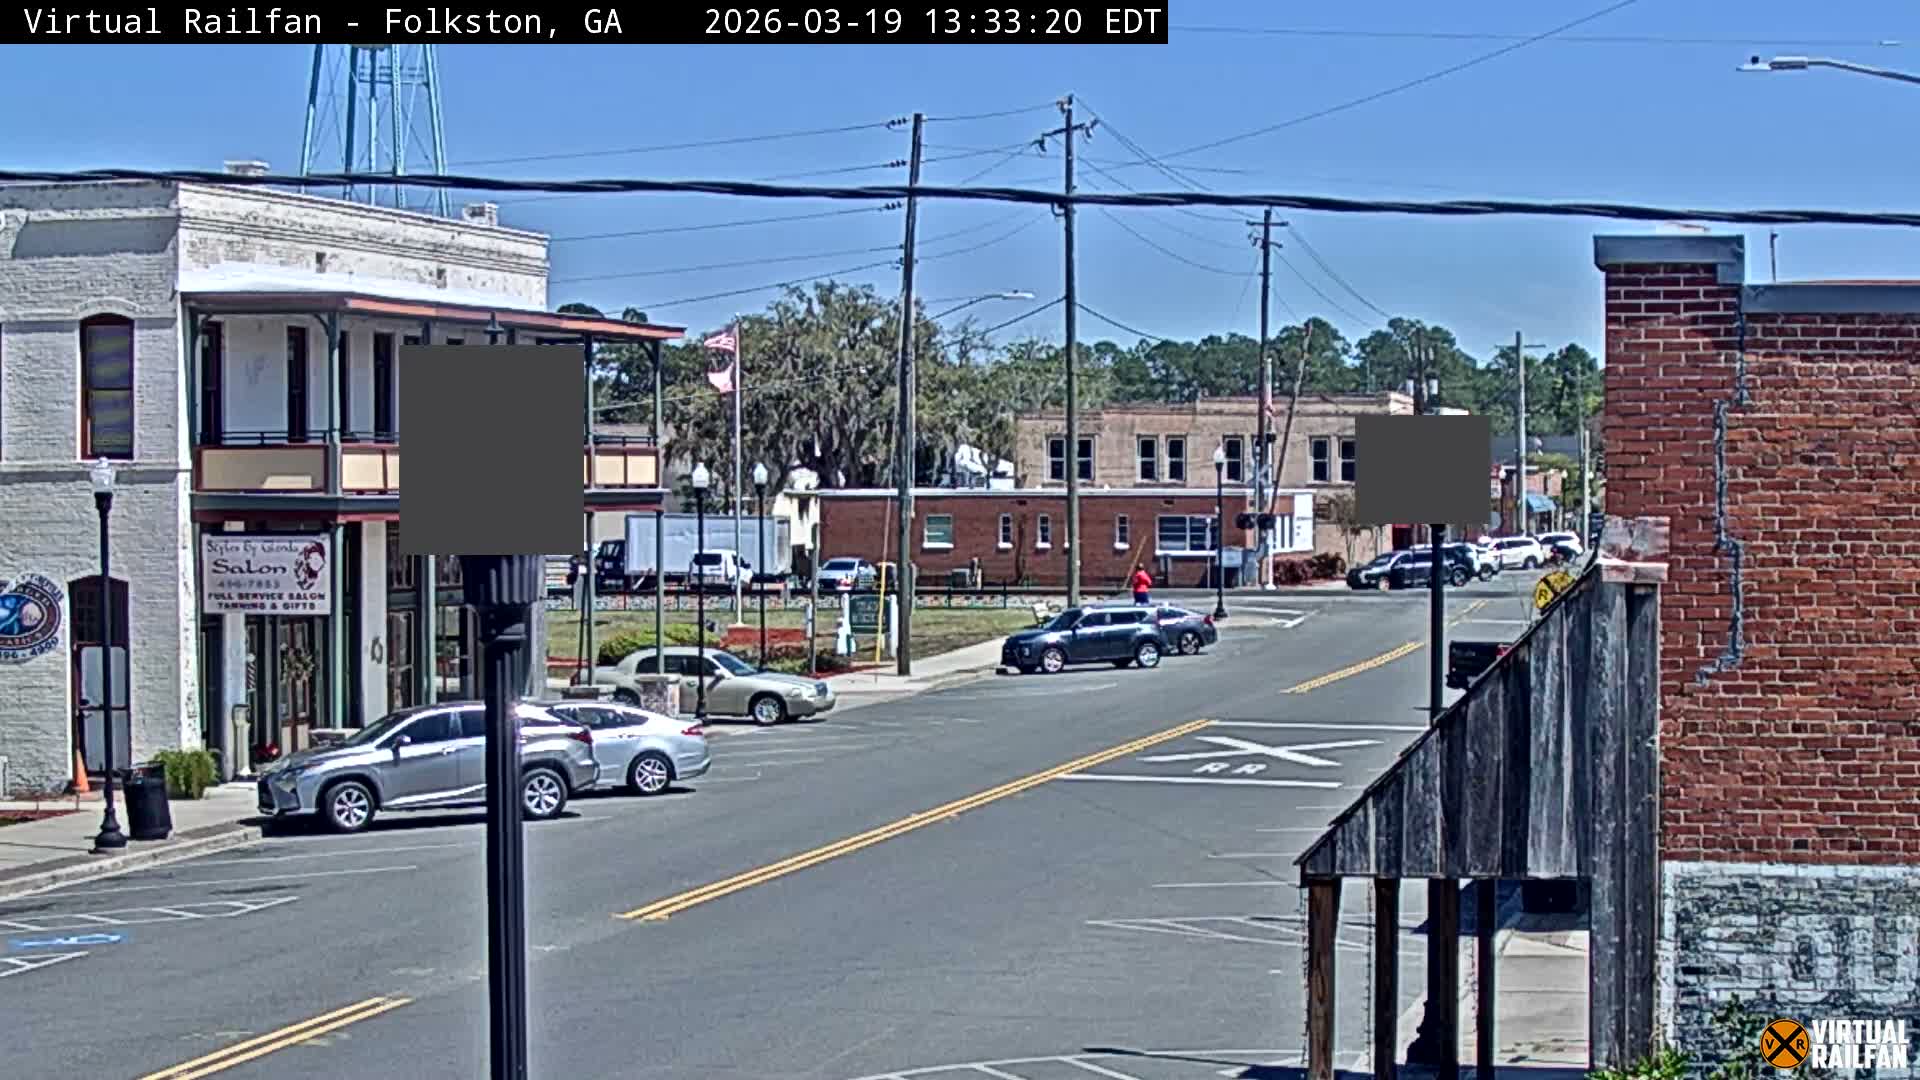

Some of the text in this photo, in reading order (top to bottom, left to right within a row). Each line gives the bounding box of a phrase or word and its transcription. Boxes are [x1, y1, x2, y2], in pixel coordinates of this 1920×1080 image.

[207, 540, 240, 556] Styles
[211, 558, 287, 574] Salon
[207, 592, 326, 600] FULL SERVICE SALON
[217, 602, 316, 610] TANNING & GIFTS
